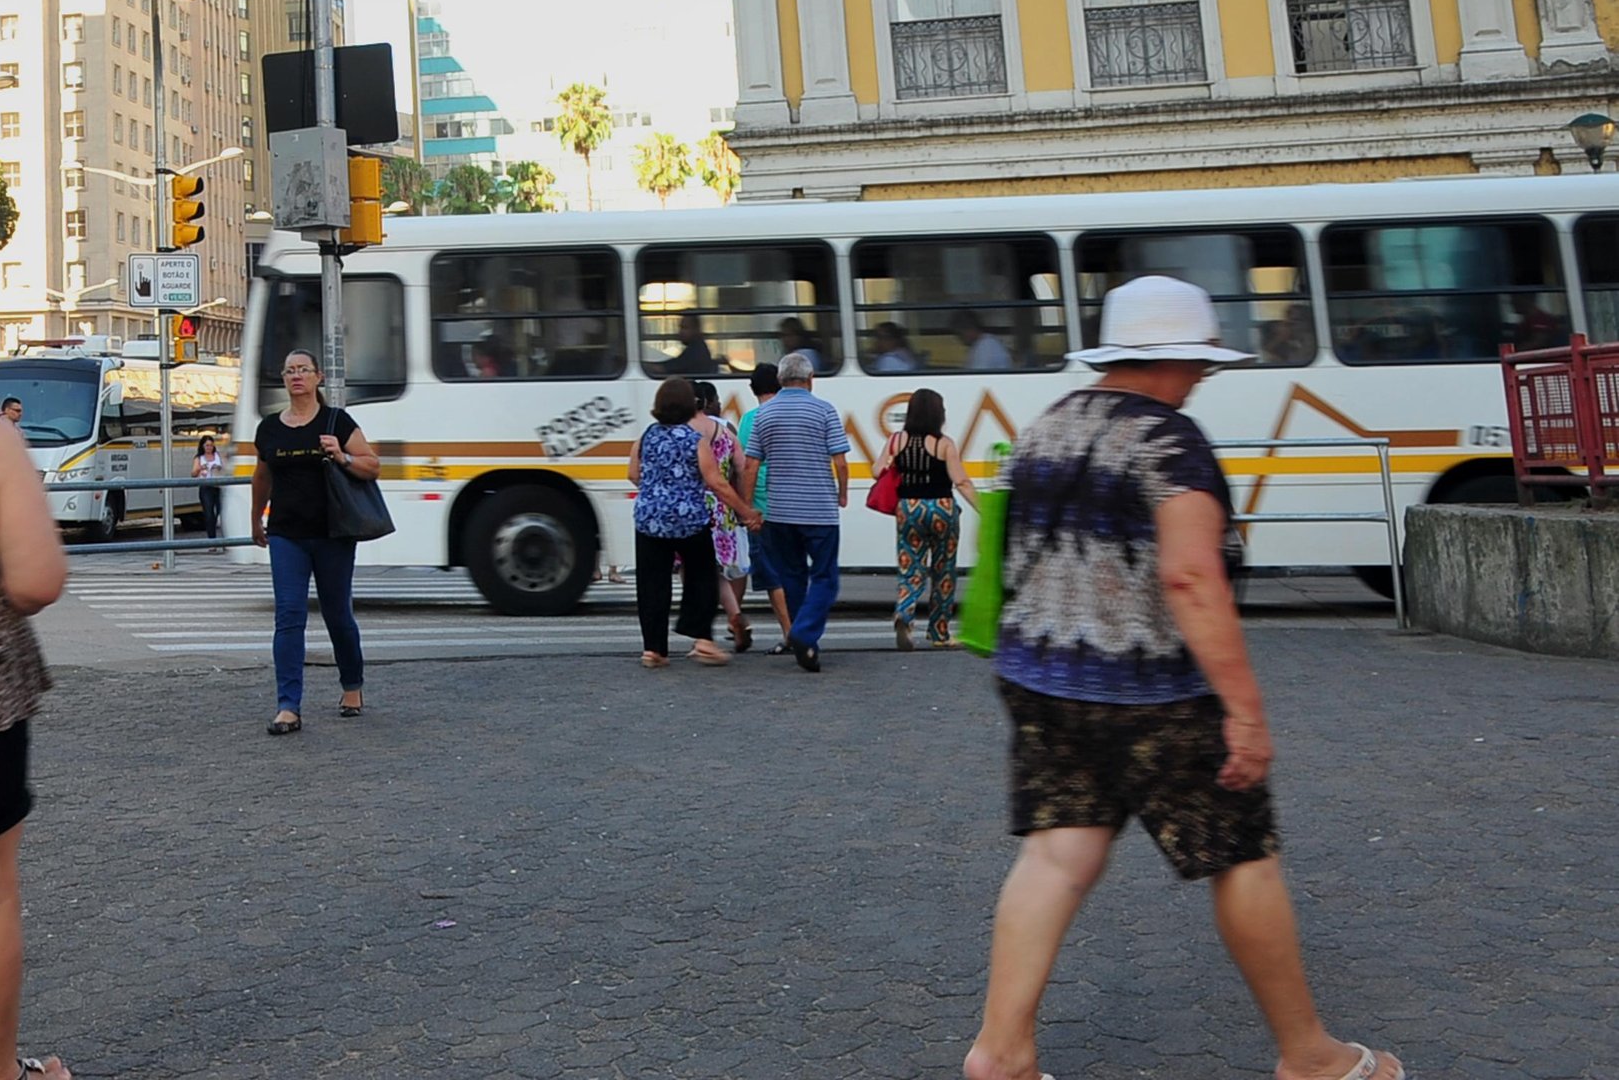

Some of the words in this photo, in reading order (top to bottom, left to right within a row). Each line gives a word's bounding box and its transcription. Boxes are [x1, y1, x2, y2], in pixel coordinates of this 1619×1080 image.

[186, 260, 192, 268] O
[161, 282, 192, 290] AGUARDE
[535, 395, 613, 442] PORTO
[545, 406, 636, 460] ALEGRE
